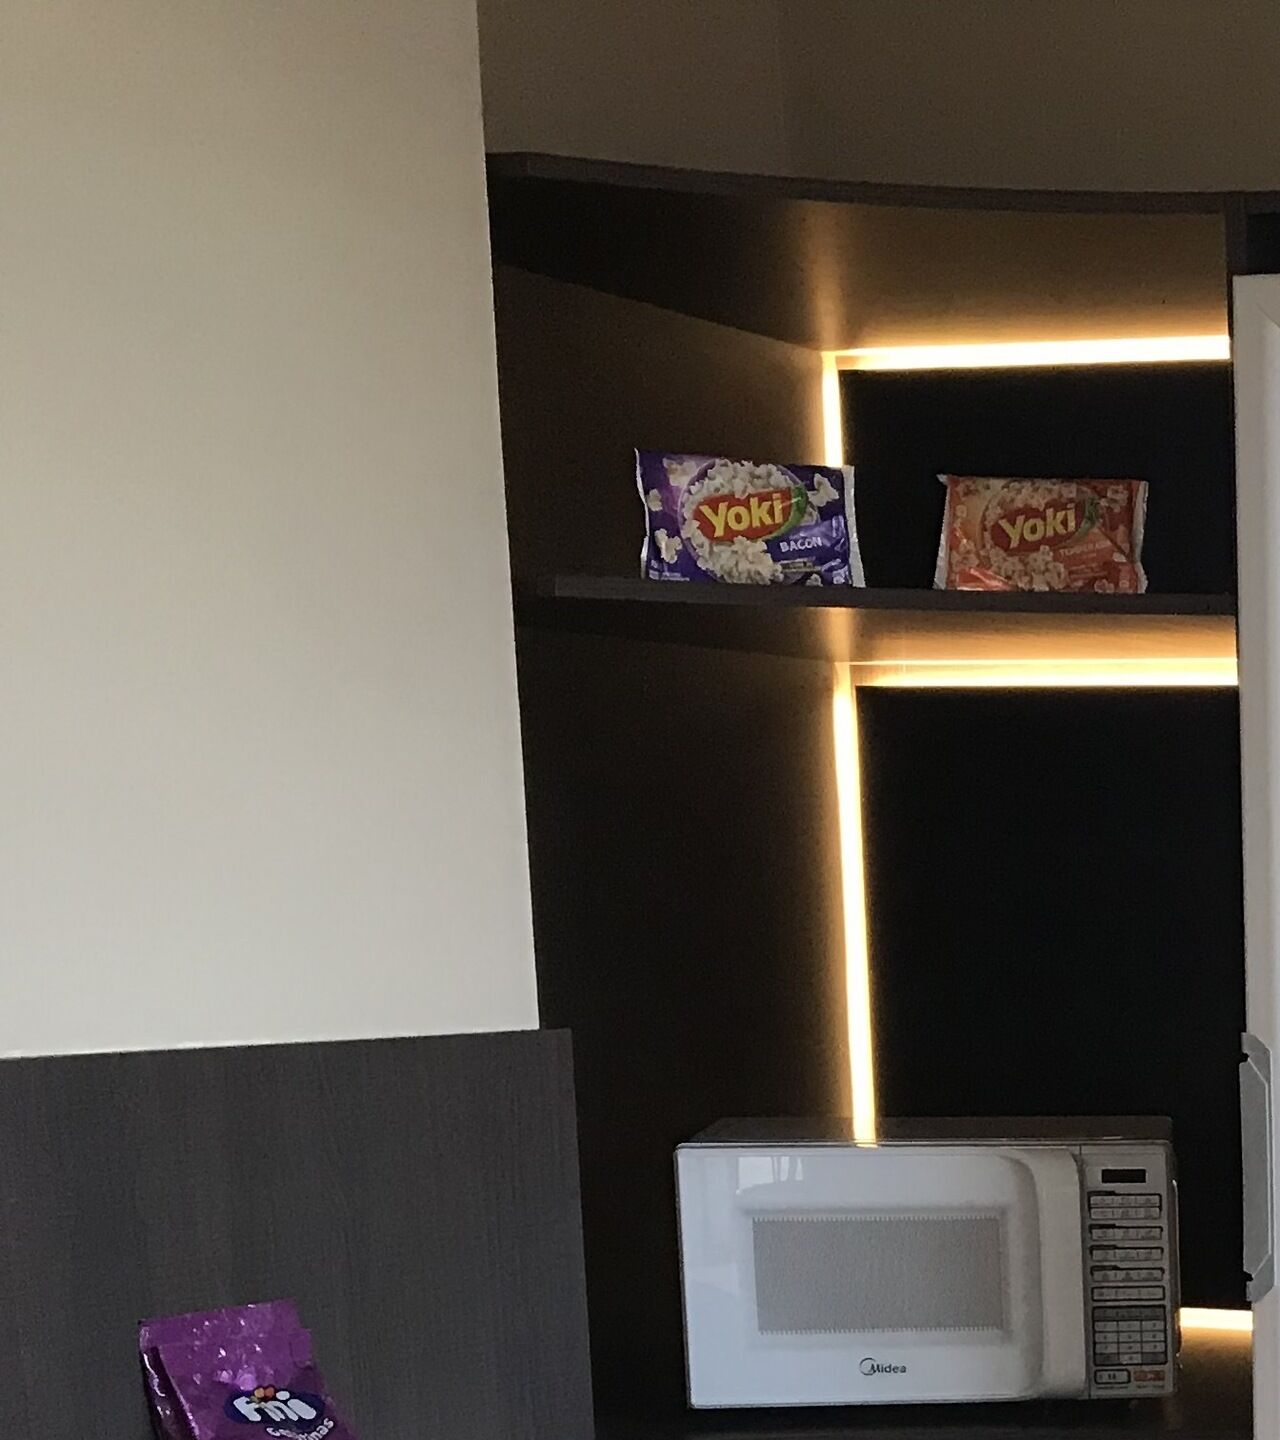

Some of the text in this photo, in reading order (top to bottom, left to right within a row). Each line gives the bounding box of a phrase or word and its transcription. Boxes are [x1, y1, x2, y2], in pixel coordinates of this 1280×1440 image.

[700, 493, 785, 538] Yoki
[999, 503, 1076, 549] Yoki
[779, 536, 823, 553] BACON
[868, 1362, 907, 1375] Midea
[233, 1387, 317, 1422] Fini
